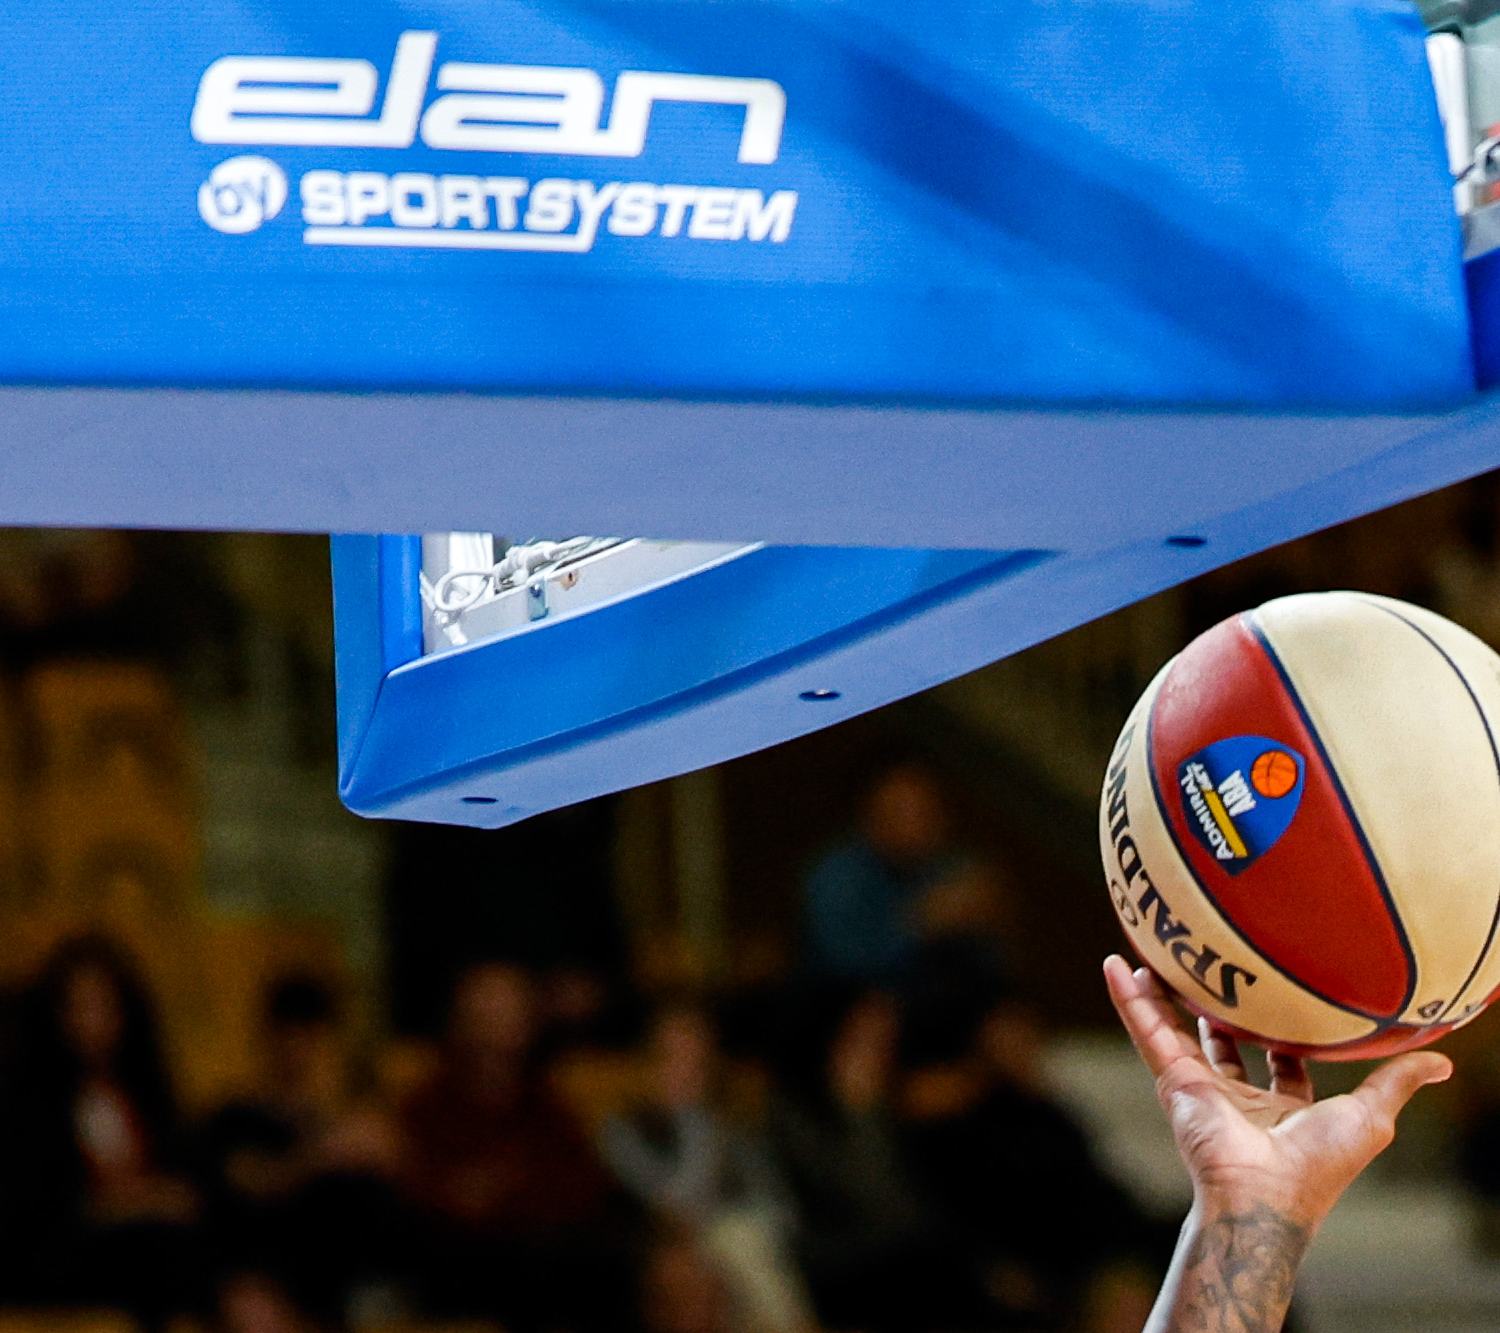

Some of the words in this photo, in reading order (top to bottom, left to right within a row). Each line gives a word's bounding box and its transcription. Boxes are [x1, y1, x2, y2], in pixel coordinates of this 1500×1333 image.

[190, 29, 788, 164] elan
[1180, 763, 1234, 860] ADMIRAL
[1217, 769, 1257, 817] ABA
